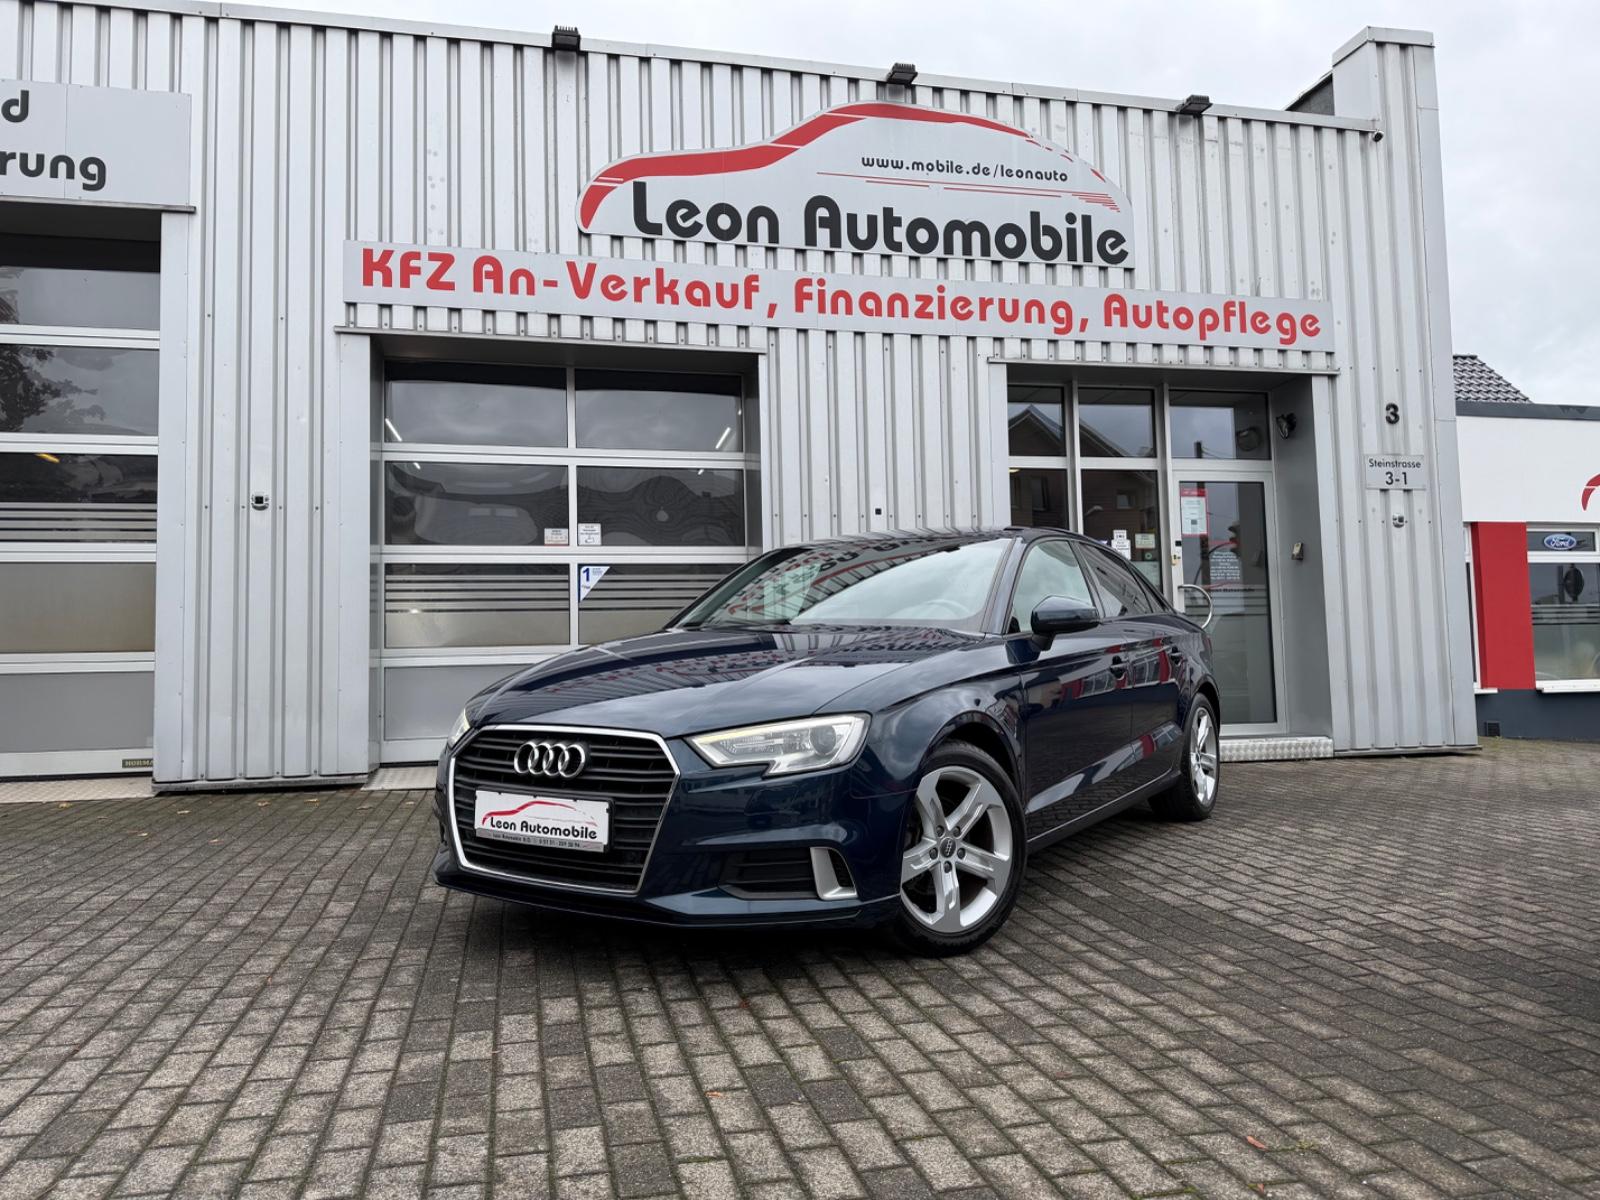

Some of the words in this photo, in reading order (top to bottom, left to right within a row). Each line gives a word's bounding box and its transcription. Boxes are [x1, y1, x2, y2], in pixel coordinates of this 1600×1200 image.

[861, 155, 1068, 182] www.mobile.de/leonauto
[633, 181, 779, 244] Leon
[804, 195, 1129, 264] Automobile
[795, 277, 1088, 336] Finanzierung,
[1104, 293, 1321, 345] Autopflege
[1385, 403, 1400, 425] 3
[1368, 458, 1422, 469] Steinstrasse
[1385, 471, 1408, 486] 3-1
[1548, 534, 1572, 548] Ford
[490, 816, 517, 831] Leon
[520, 820, 598, 840] Automobile
